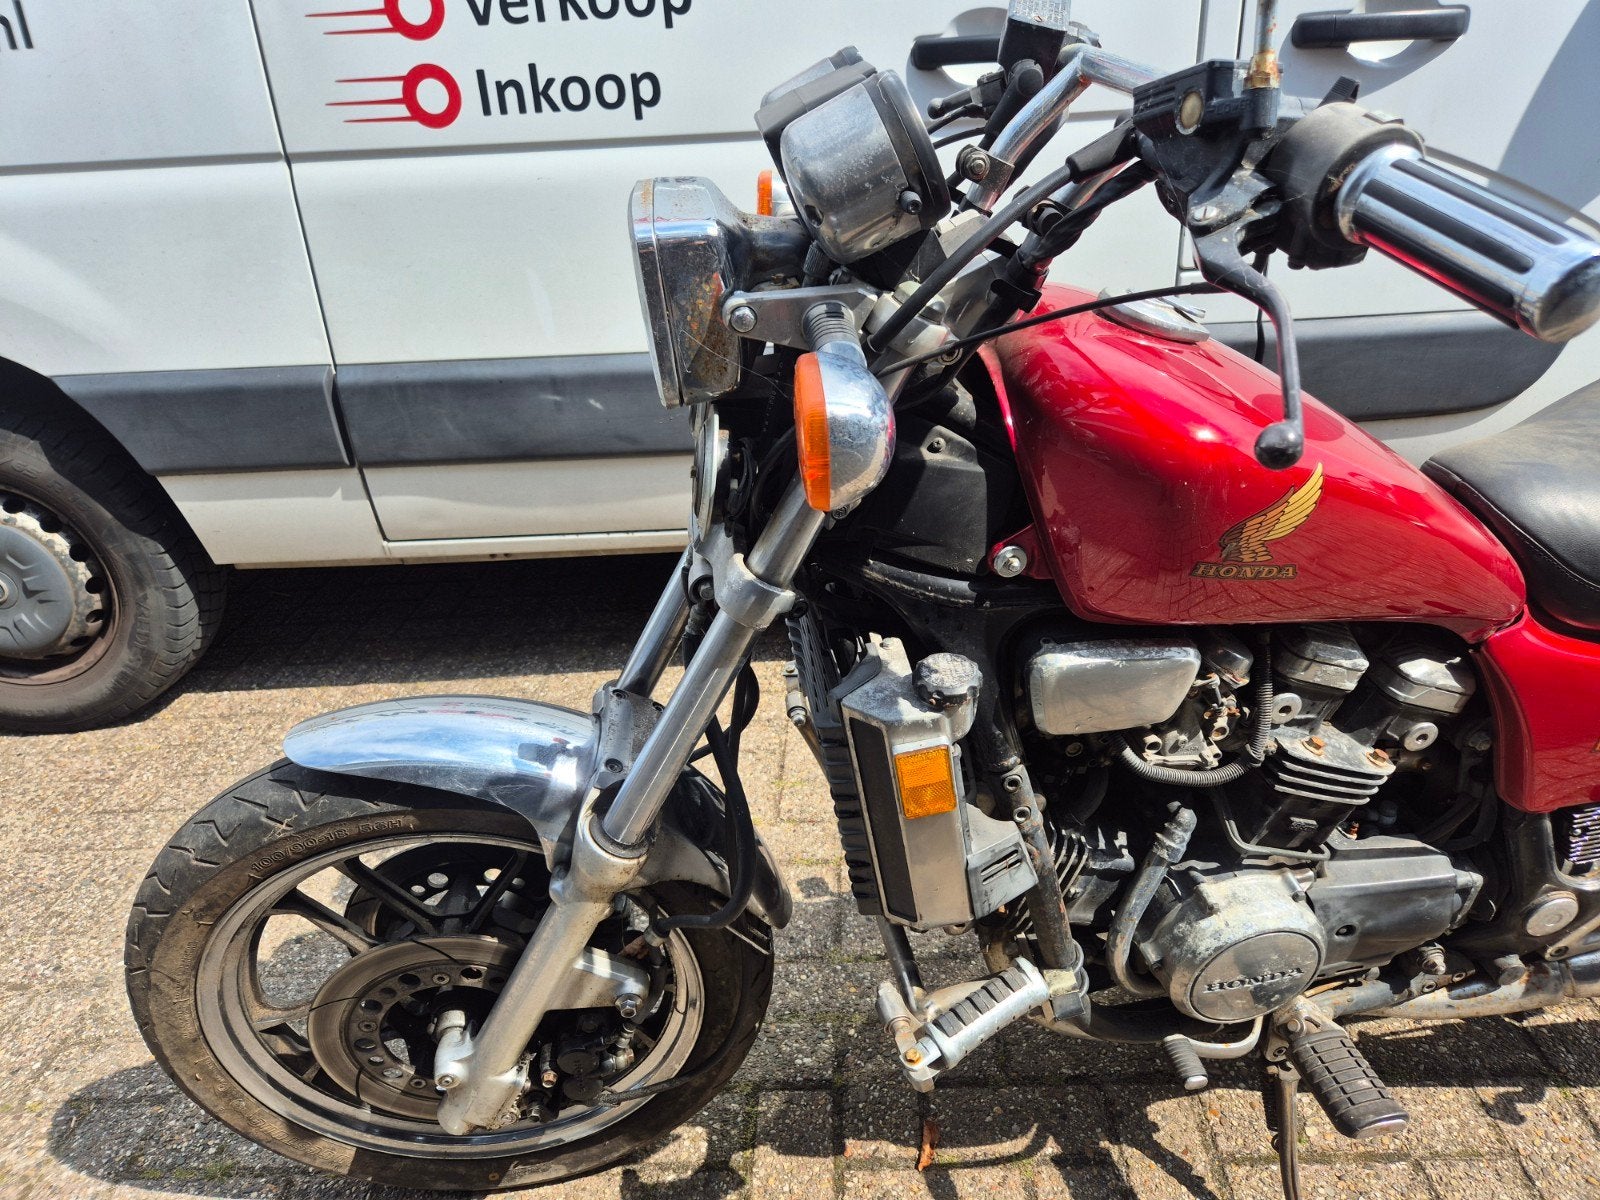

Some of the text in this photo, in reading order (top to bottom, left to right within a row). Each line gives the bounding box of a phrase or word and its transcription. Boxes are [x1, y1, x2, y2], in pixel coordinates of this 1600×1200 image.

[476, 63, 661, 120] Inkoop
[1193, 562, 1297, 579] HONDA
[1203, 967, 1304, 993] HONDA
